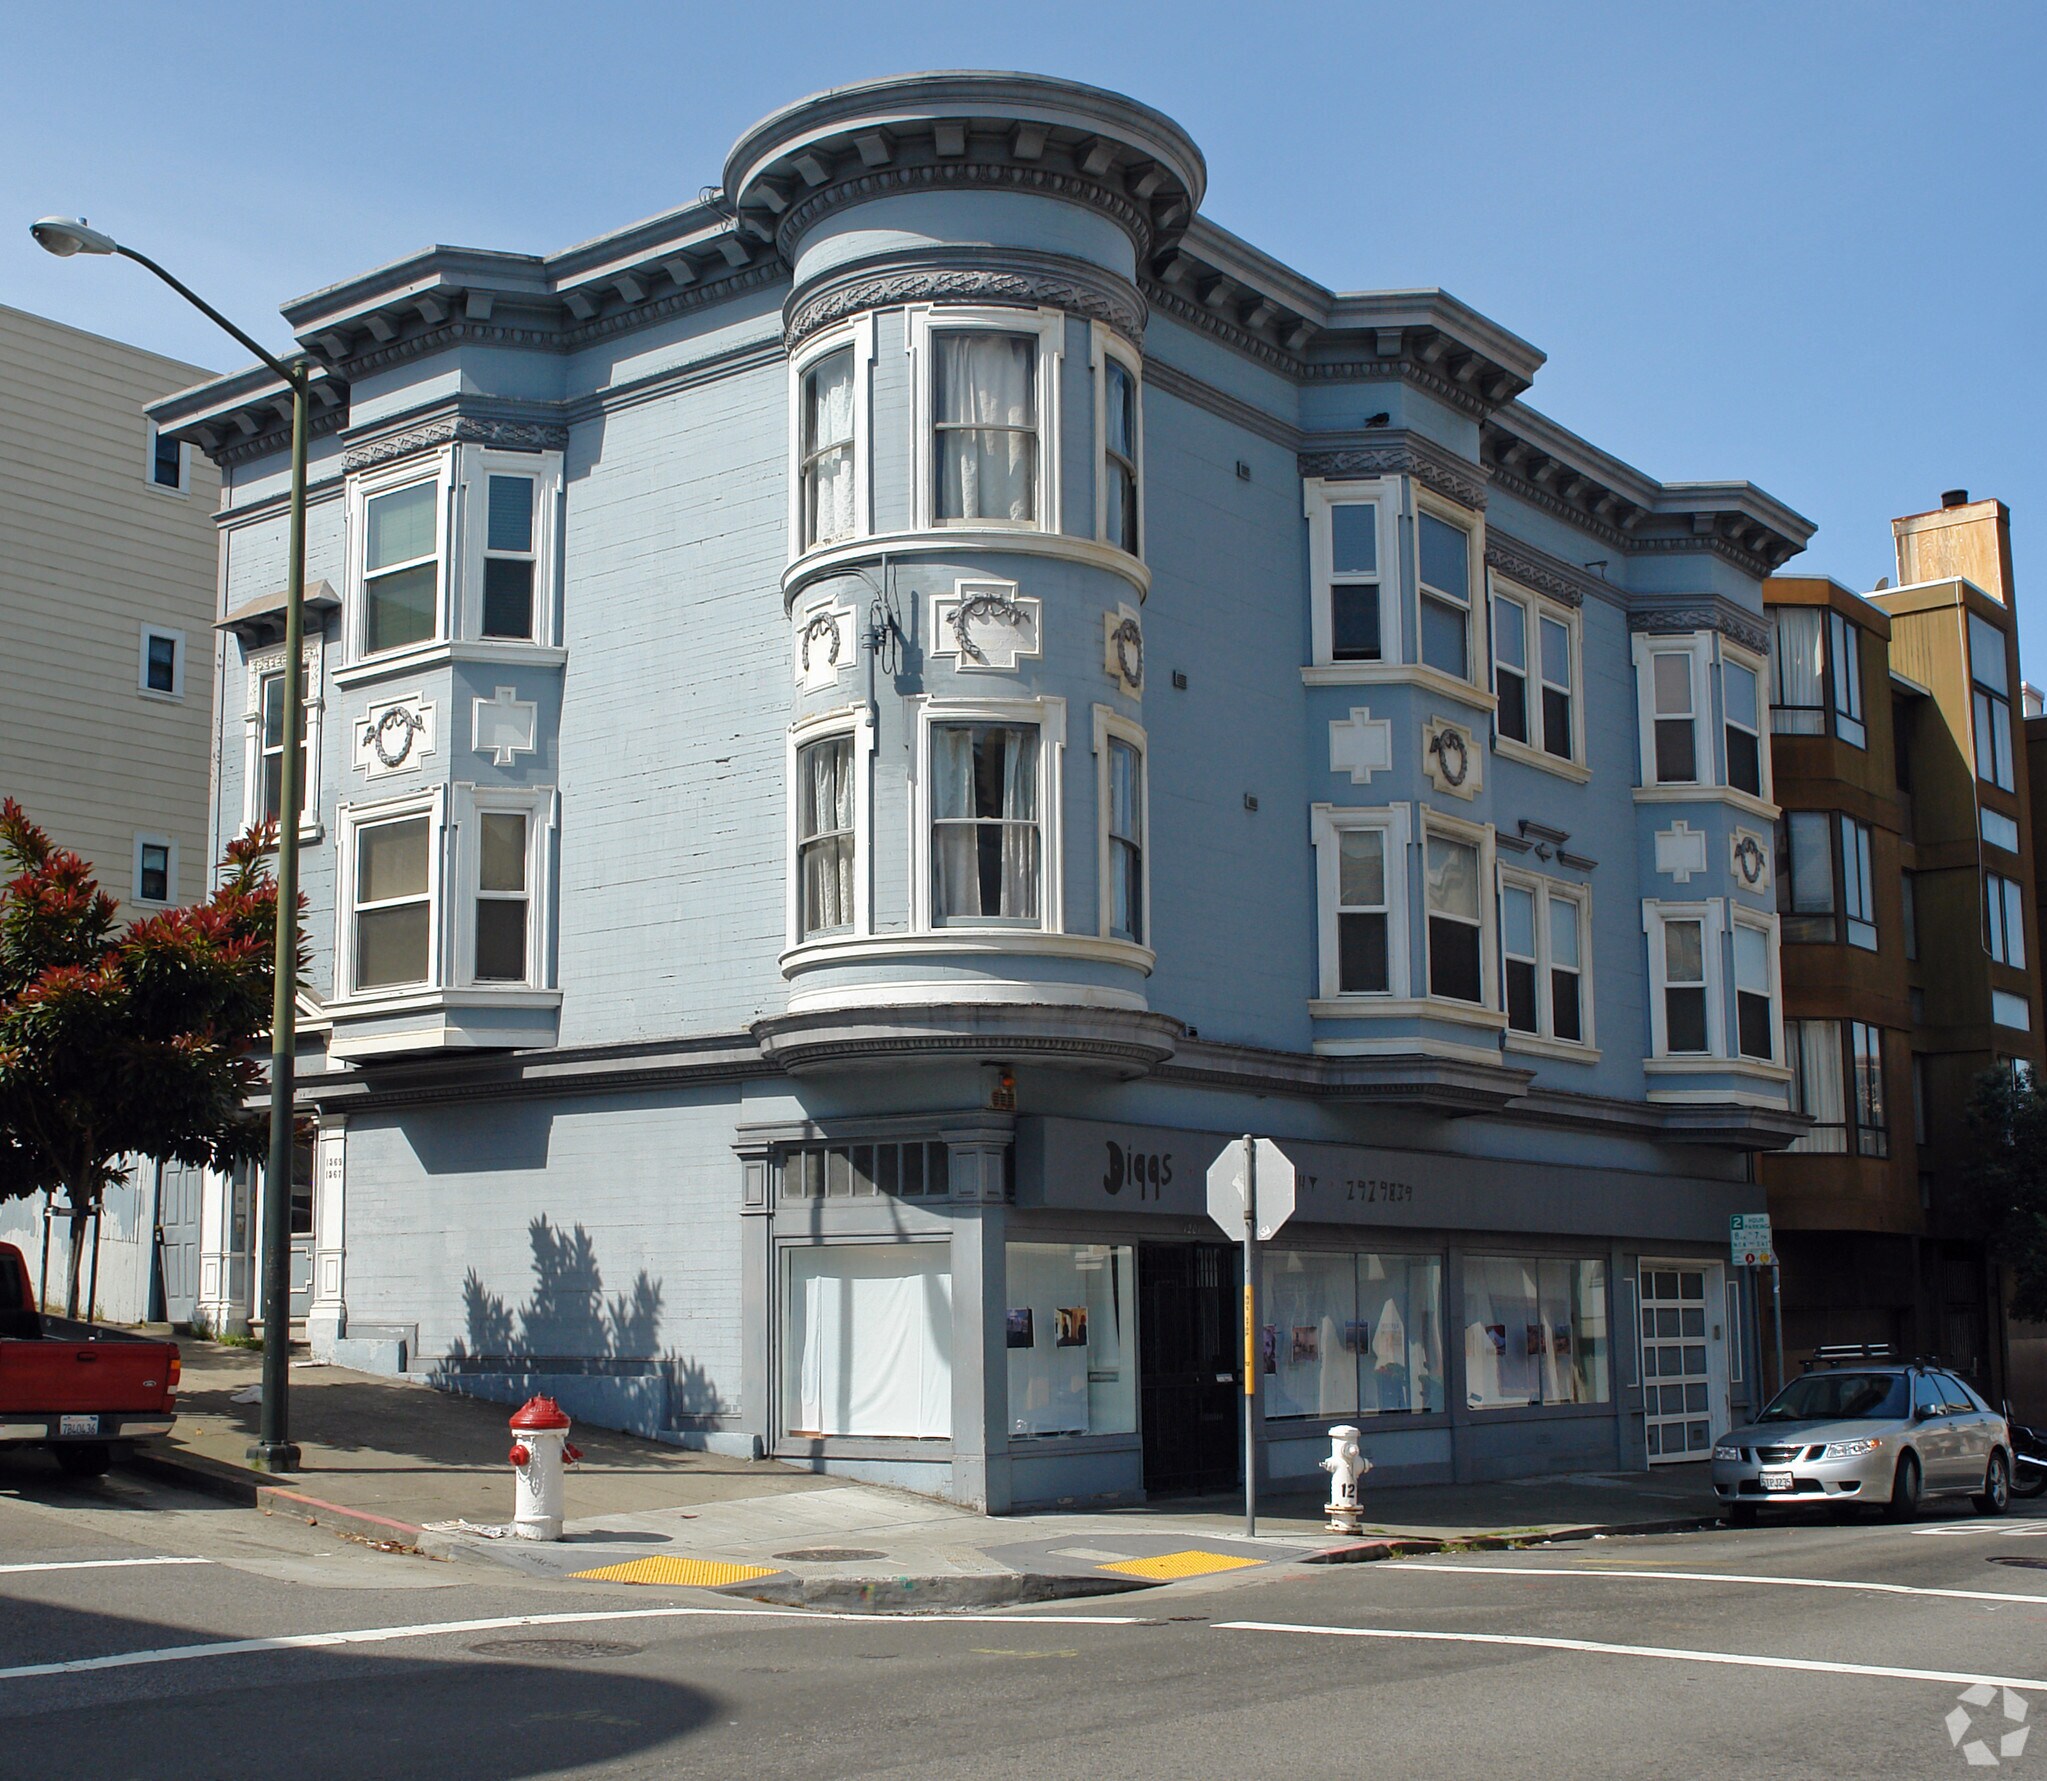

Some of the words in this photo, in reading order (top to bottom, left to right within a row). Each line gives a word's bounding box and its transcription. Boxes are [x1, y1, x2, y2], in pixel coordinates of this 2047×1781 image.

[1346, 1180, 1413, 1202] 2929839
[1733, 1217, 1742, 1228] 2
[1341, 1483, 1355, 1498] 12
